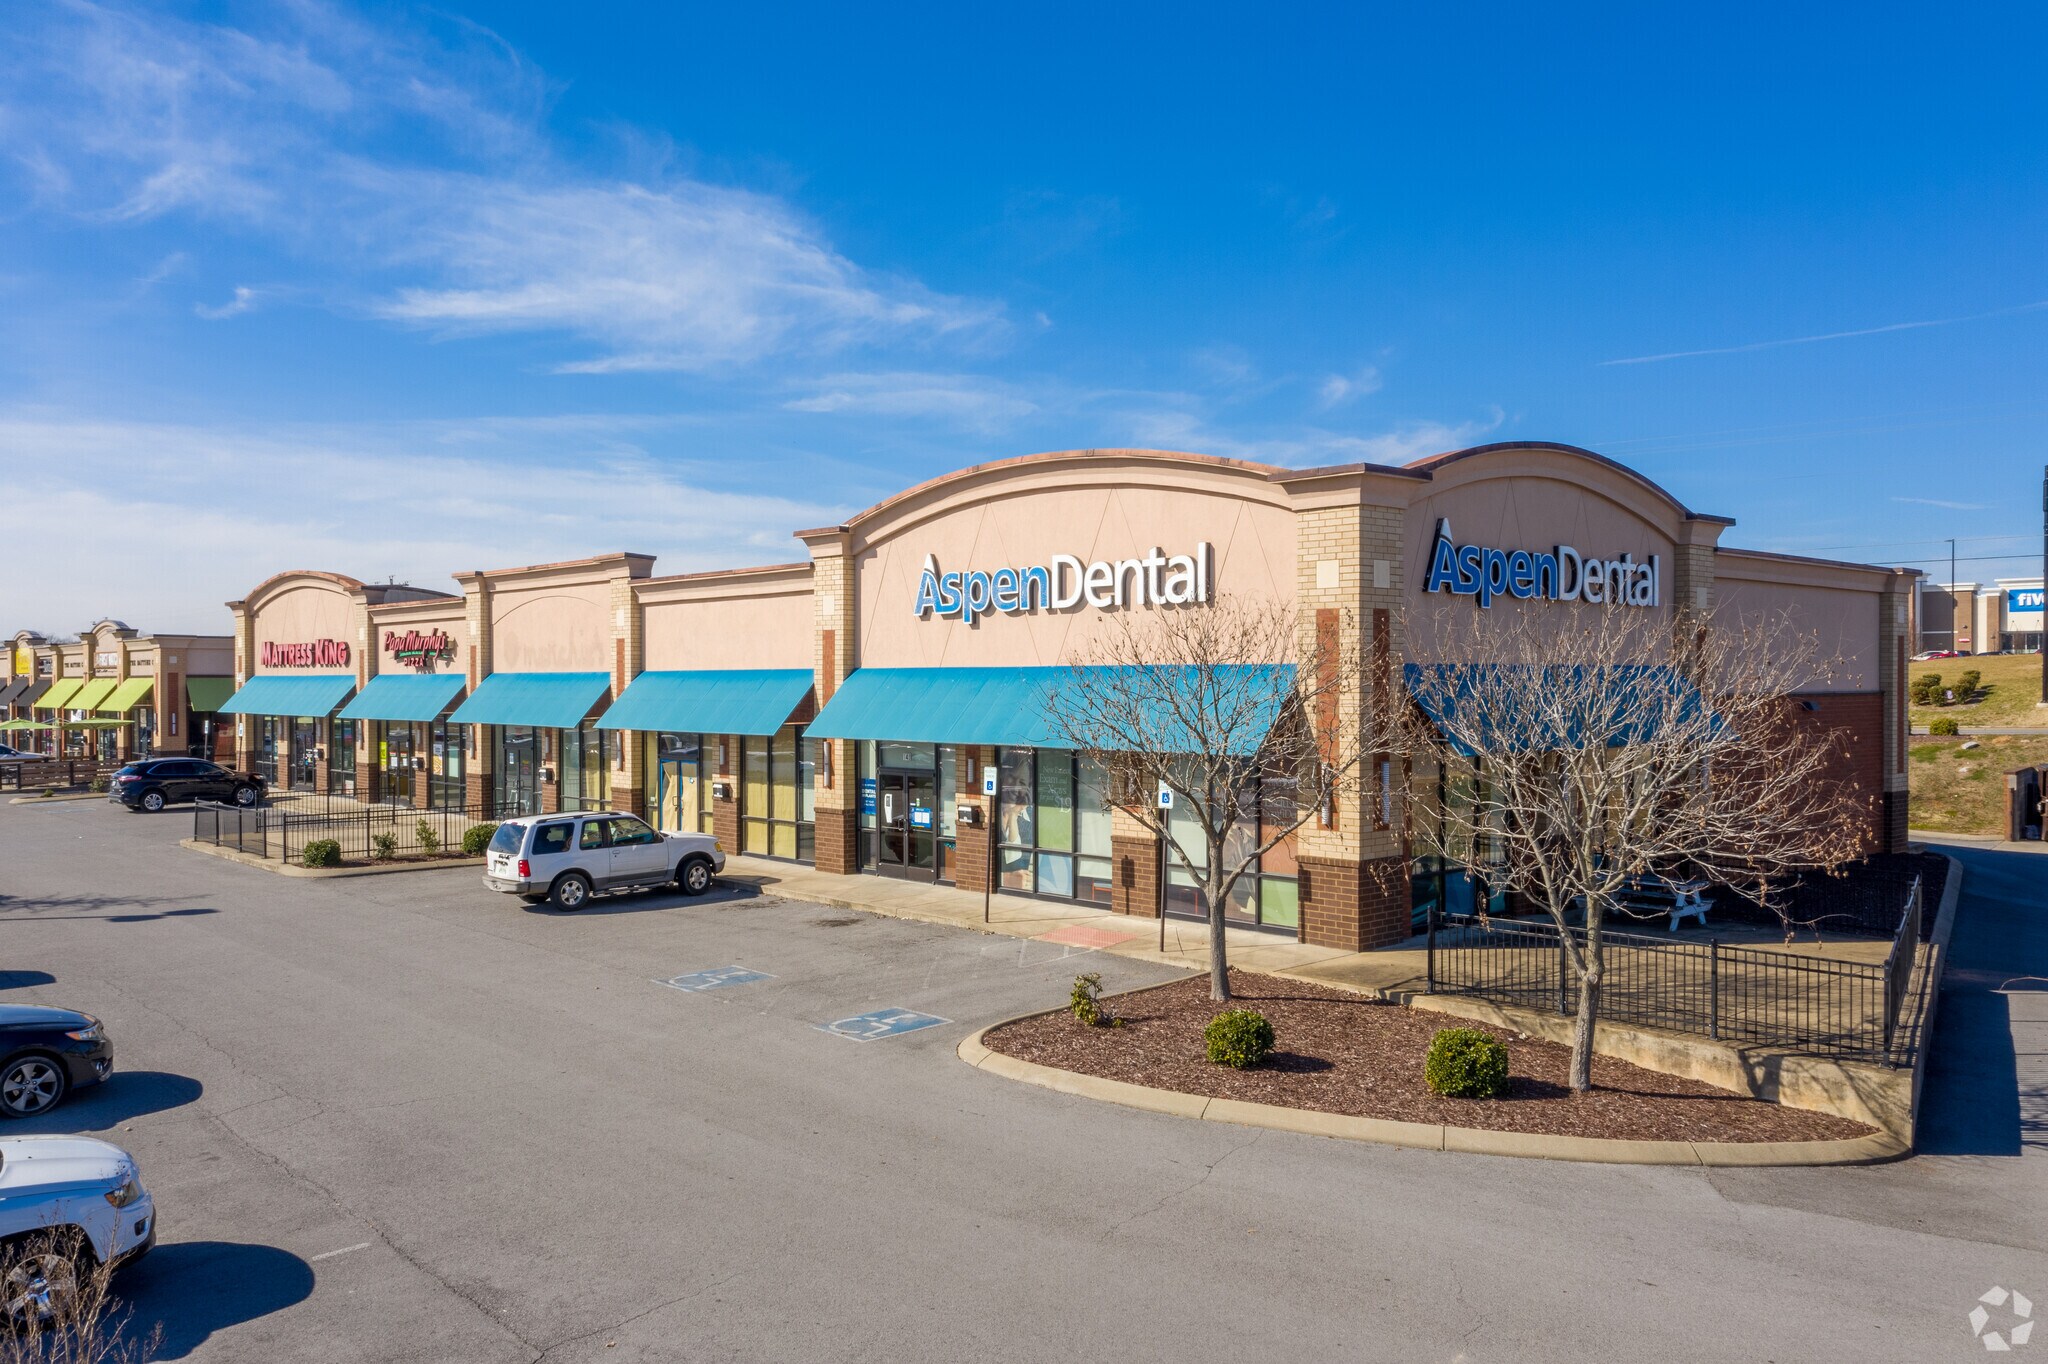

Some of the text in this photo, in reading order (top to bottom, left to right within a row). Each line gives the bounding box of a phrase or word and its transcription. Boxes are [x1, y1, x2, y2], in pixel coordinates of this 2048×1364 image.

[914, 542, 1208, 624] AspenDental
[2017, 593, 2044, 606] fiv
[261, 641, 313, 665] MATTRESS
[385, 628, 446, 660] Papa Murphy's
[404, 658, 424, 667] PIZZA
